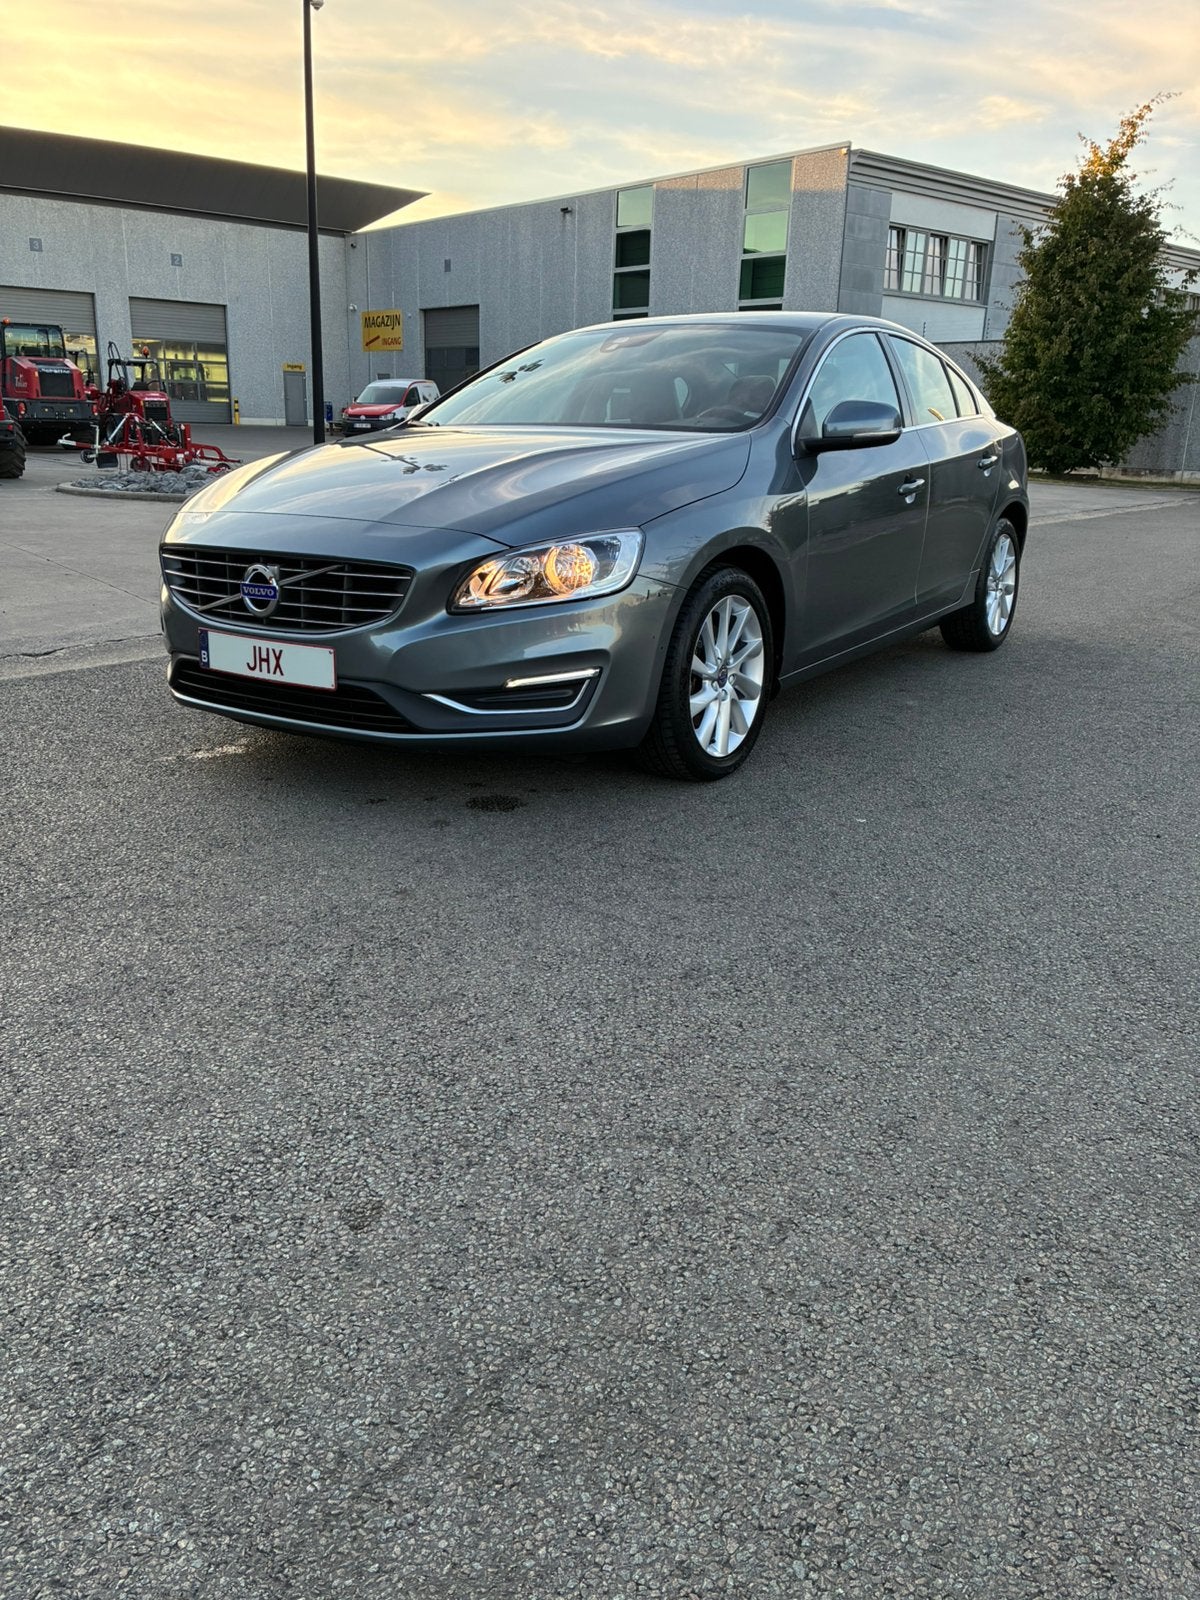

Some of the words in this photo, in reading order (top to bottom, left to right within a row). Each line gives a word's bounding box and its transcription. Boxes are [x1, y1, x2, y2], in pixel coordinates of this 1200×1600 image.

[364, 314, 400, 330] MAGAZIJN
[243, 586, 274, 597] VOLVO
[201, 650, 208, 662] B
[246, 645, 284, 676] JHX
